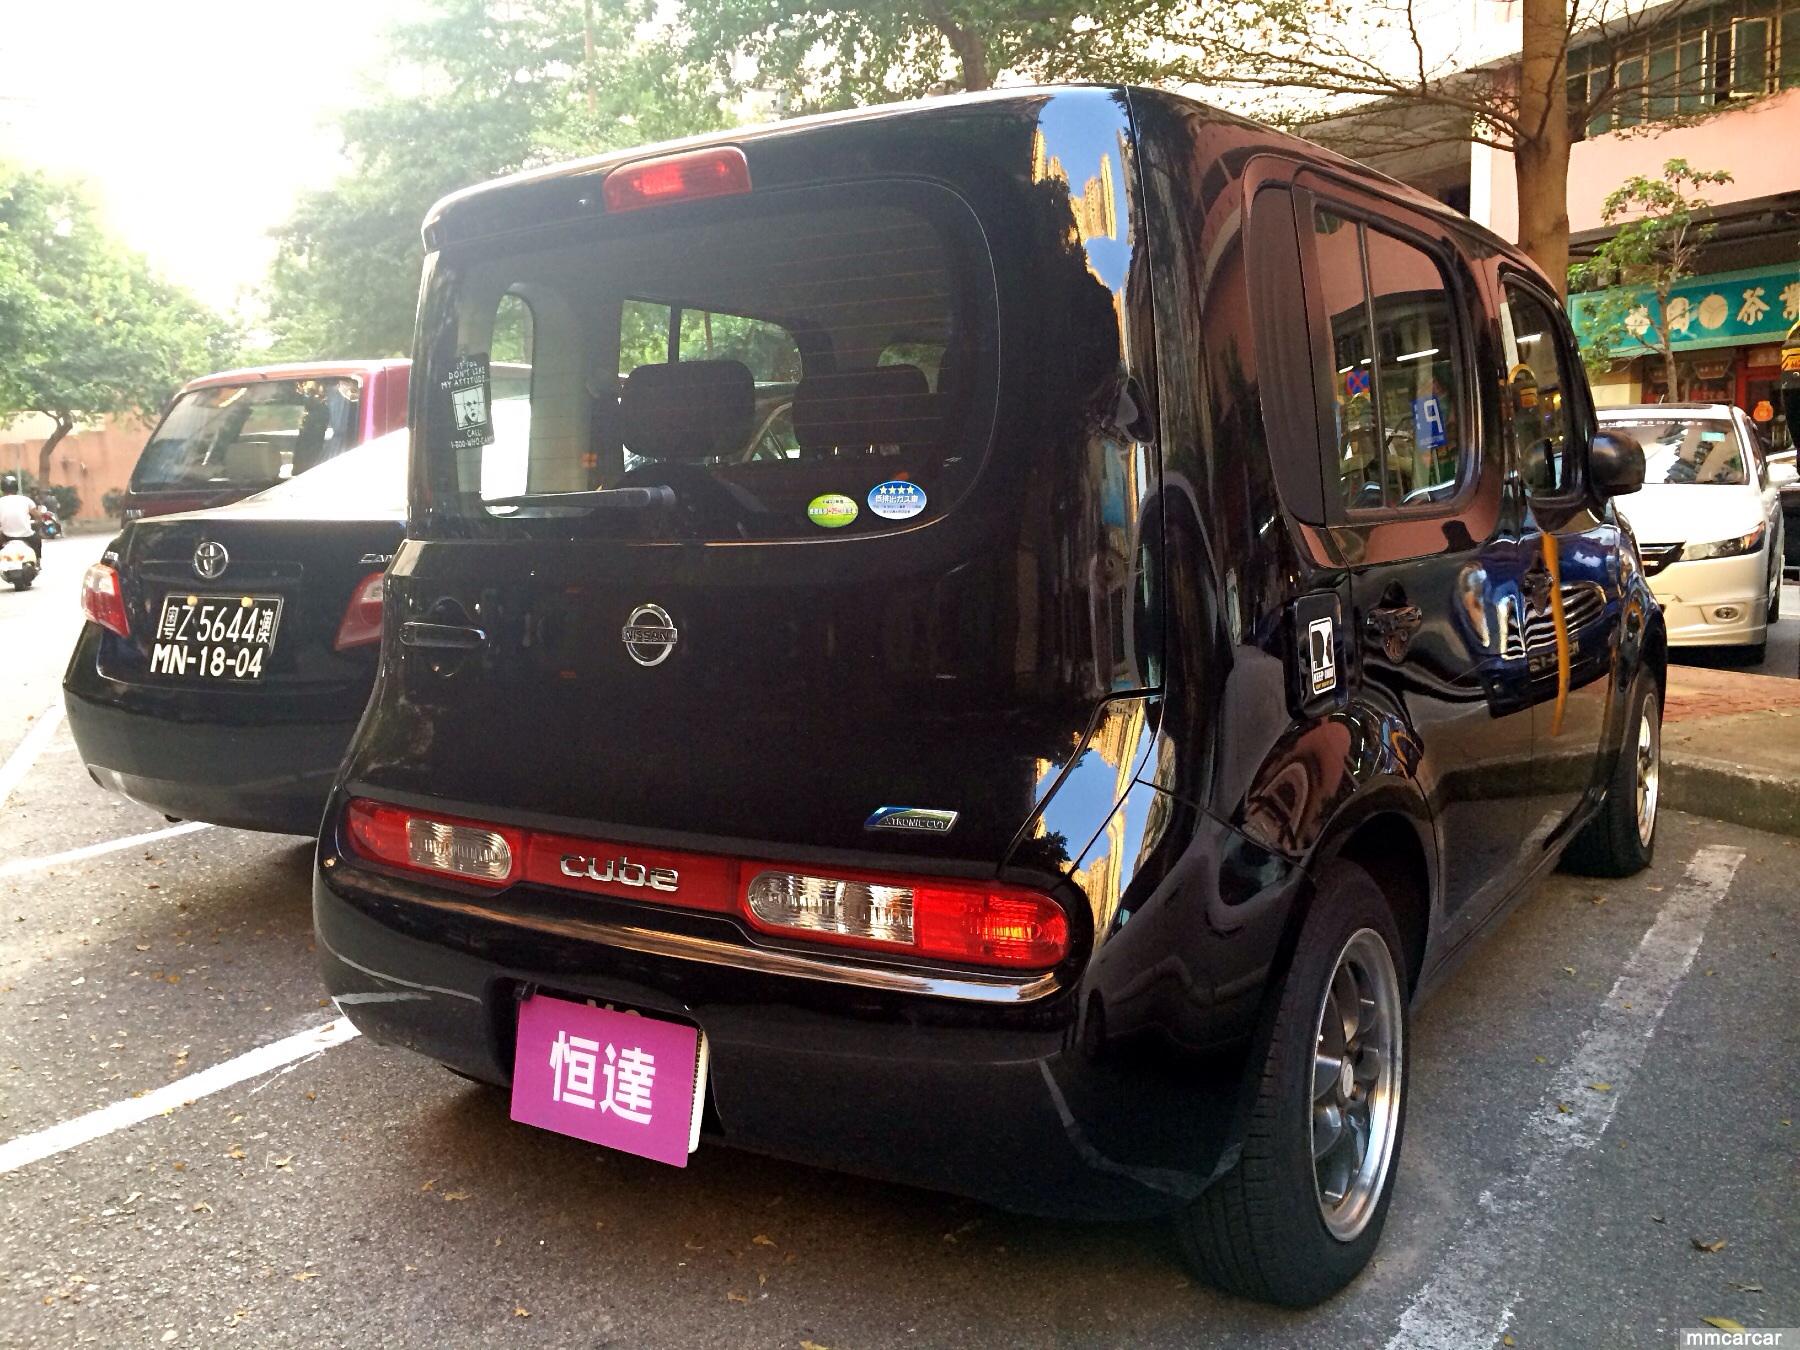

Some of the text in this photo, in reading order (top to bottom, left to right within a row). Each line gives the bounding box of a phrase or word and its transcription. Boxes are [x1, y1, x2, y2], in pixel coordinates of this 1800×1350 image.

[441, 375, 485, 390] MY ATTITUDE
[448, 369, 469, 380] DON'T
[623, 629, 672, 642] NISSAN
[150, 643, 264, 679] MN-18-04
[560, 855, 679, 892] cube
[549, 1030, 656, 1125] 恒達
